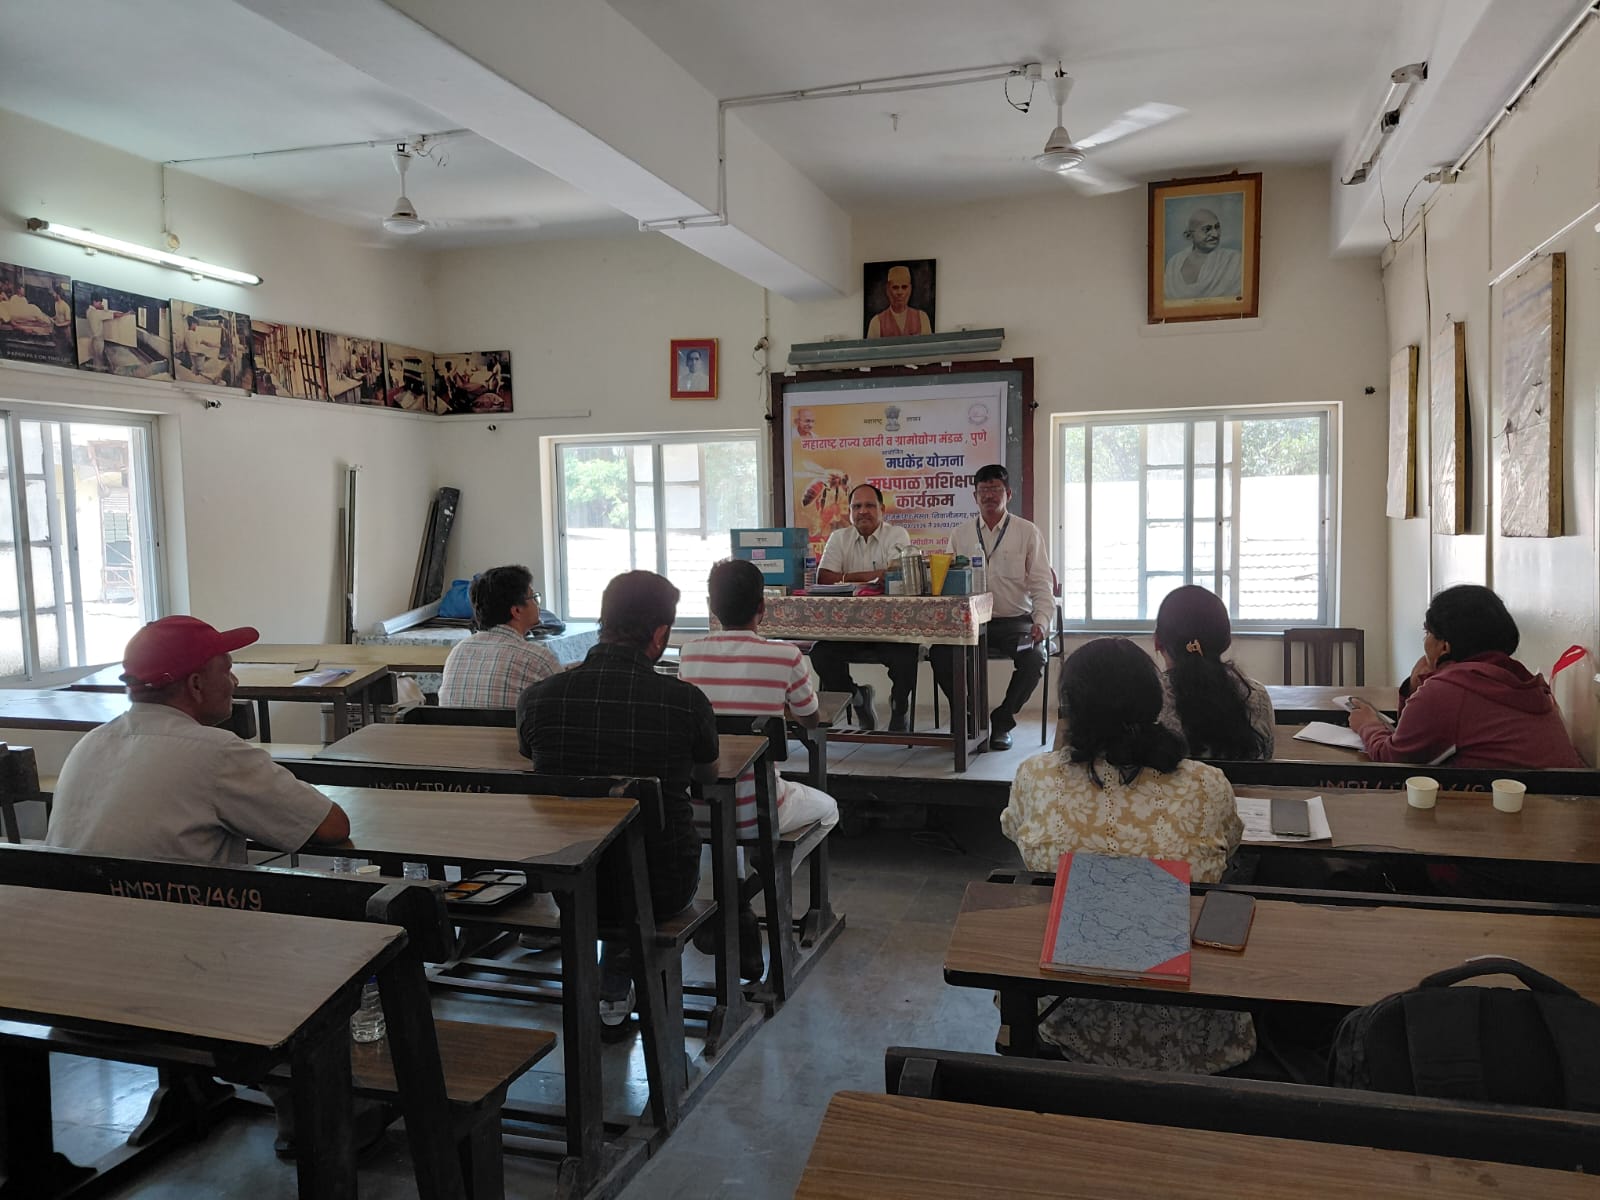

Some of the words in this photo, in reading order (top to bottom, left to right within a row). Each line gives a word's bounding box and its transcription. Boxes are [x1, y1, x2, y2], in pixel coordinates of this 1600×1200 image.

[802, 438, 837, 450] महाराष्ट्र
[839, 437, 860, 449] राज्य
[863, 434, 884, 448] खादी
[886, 436, 893, 446] व
[895, 432, 937, 446] ग्रामोद्योग
[970, 429, 987, 446] पुणे
[926, 453, 965, 468] योजना
[896, 491, 955, 508] कार्यक्रम
